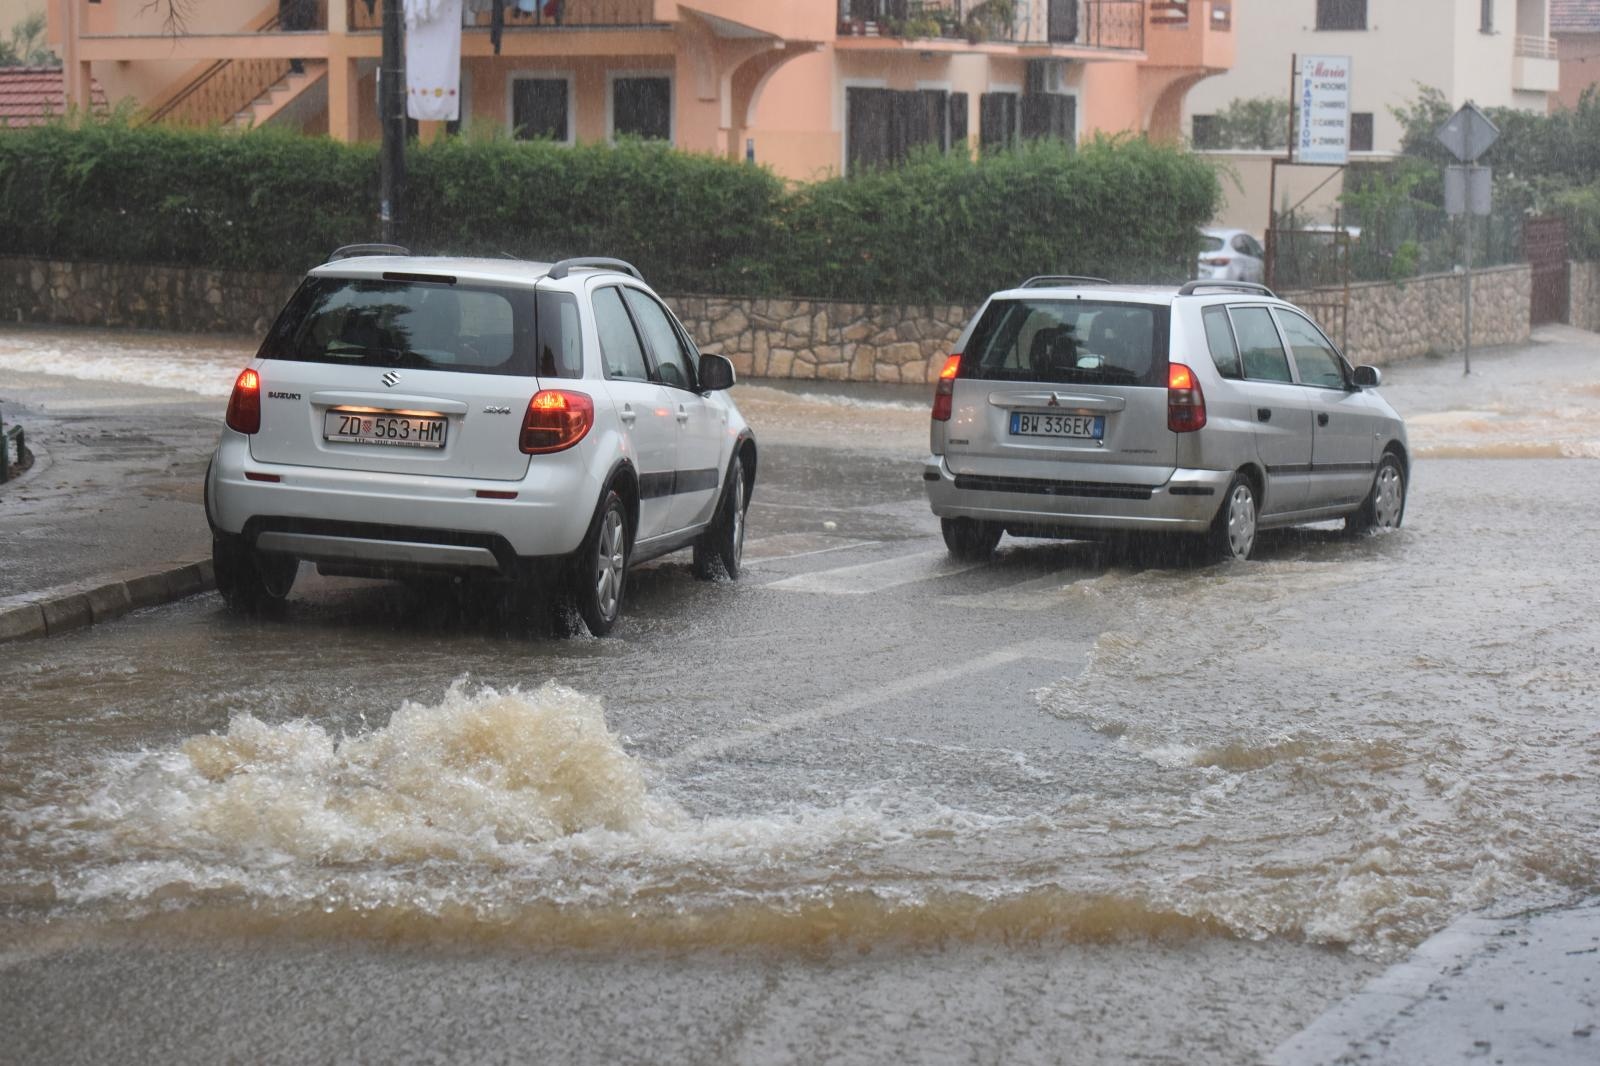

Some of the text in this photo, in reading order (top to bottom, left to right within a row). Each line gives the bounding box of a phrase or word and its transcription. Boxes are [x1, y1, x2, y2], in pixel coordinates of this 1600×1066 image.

[1320, 82, 1346, 91] ROOMS
[1302, 79, 1312, 148] PANSION
[1318, 137, 1344, 146] ZIMMER
[268, 391, 301, 400] SUZUKI
[338, 415, 443, 441] ZD 563-HM
[1021, 415, 1091, 435] BW 336EK
